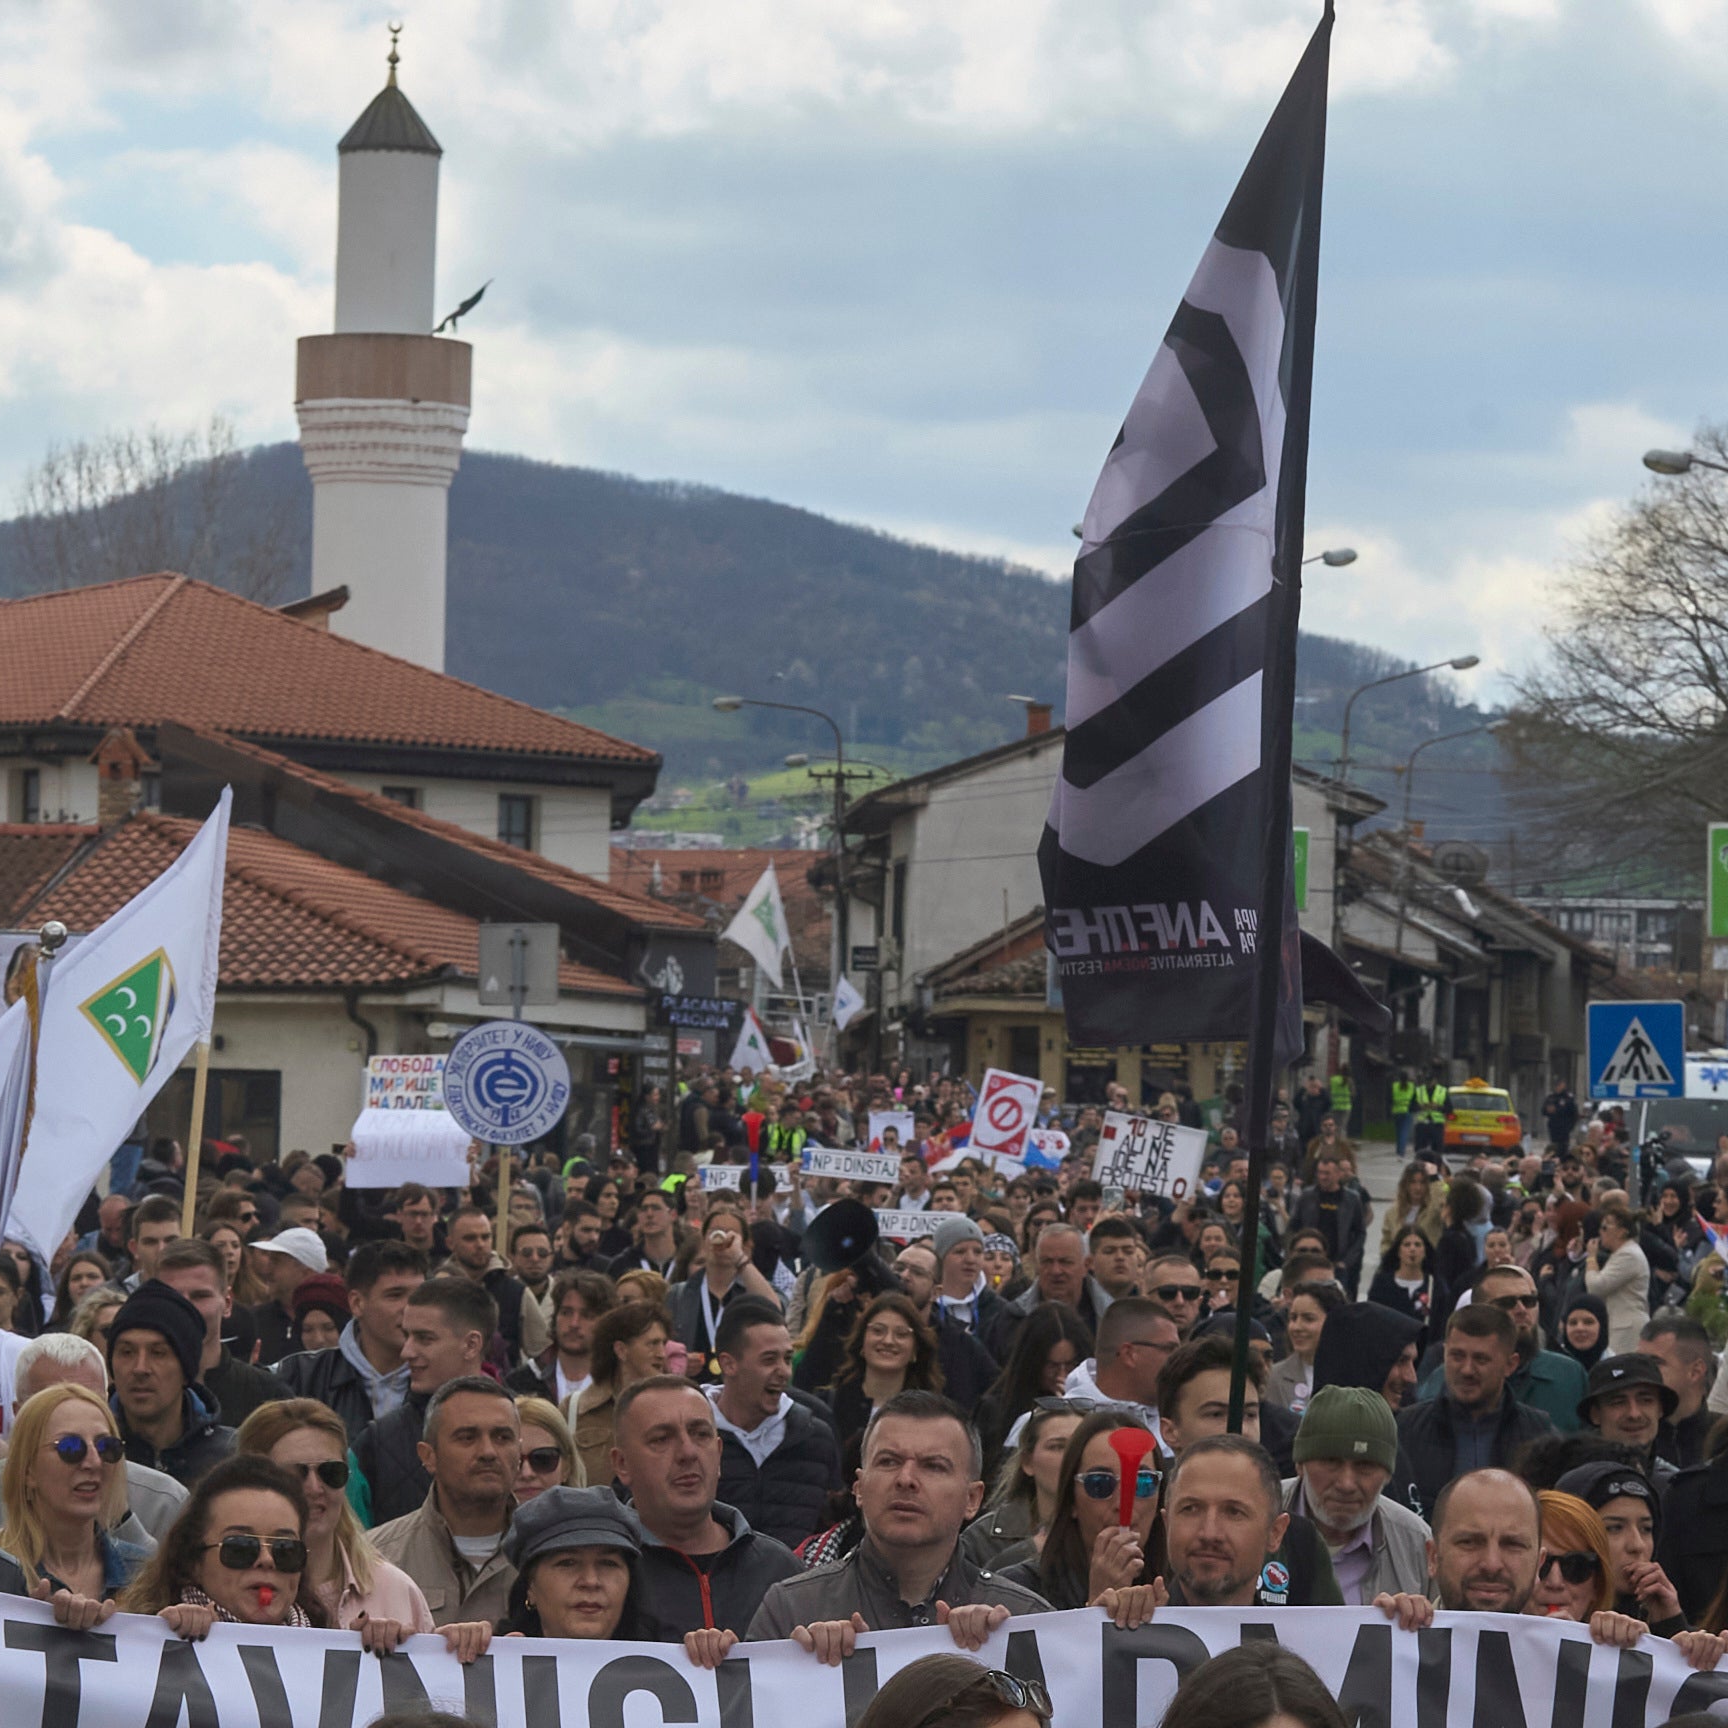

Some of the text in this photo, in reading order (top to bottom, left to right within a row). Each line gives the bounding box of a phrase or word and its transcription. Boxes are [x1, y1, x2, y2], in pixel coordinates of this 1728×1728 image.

[371, 1056, 445, 1074] СЛОБОДА
[371, 1076, 438, 1093] МИРИШЕ
[369, 1095, 390, 1110] НА
[1152, 1122, 1177, 1142] JE
[1152, 1140, 1174, 1161] NE
[812, 1155, 832, 1171] NP
[1145, 1157, 1170, 1180] NA
[708, 1170, 728, 1185] NP
[1099, 1166, 1169, 1196] PROTEST
